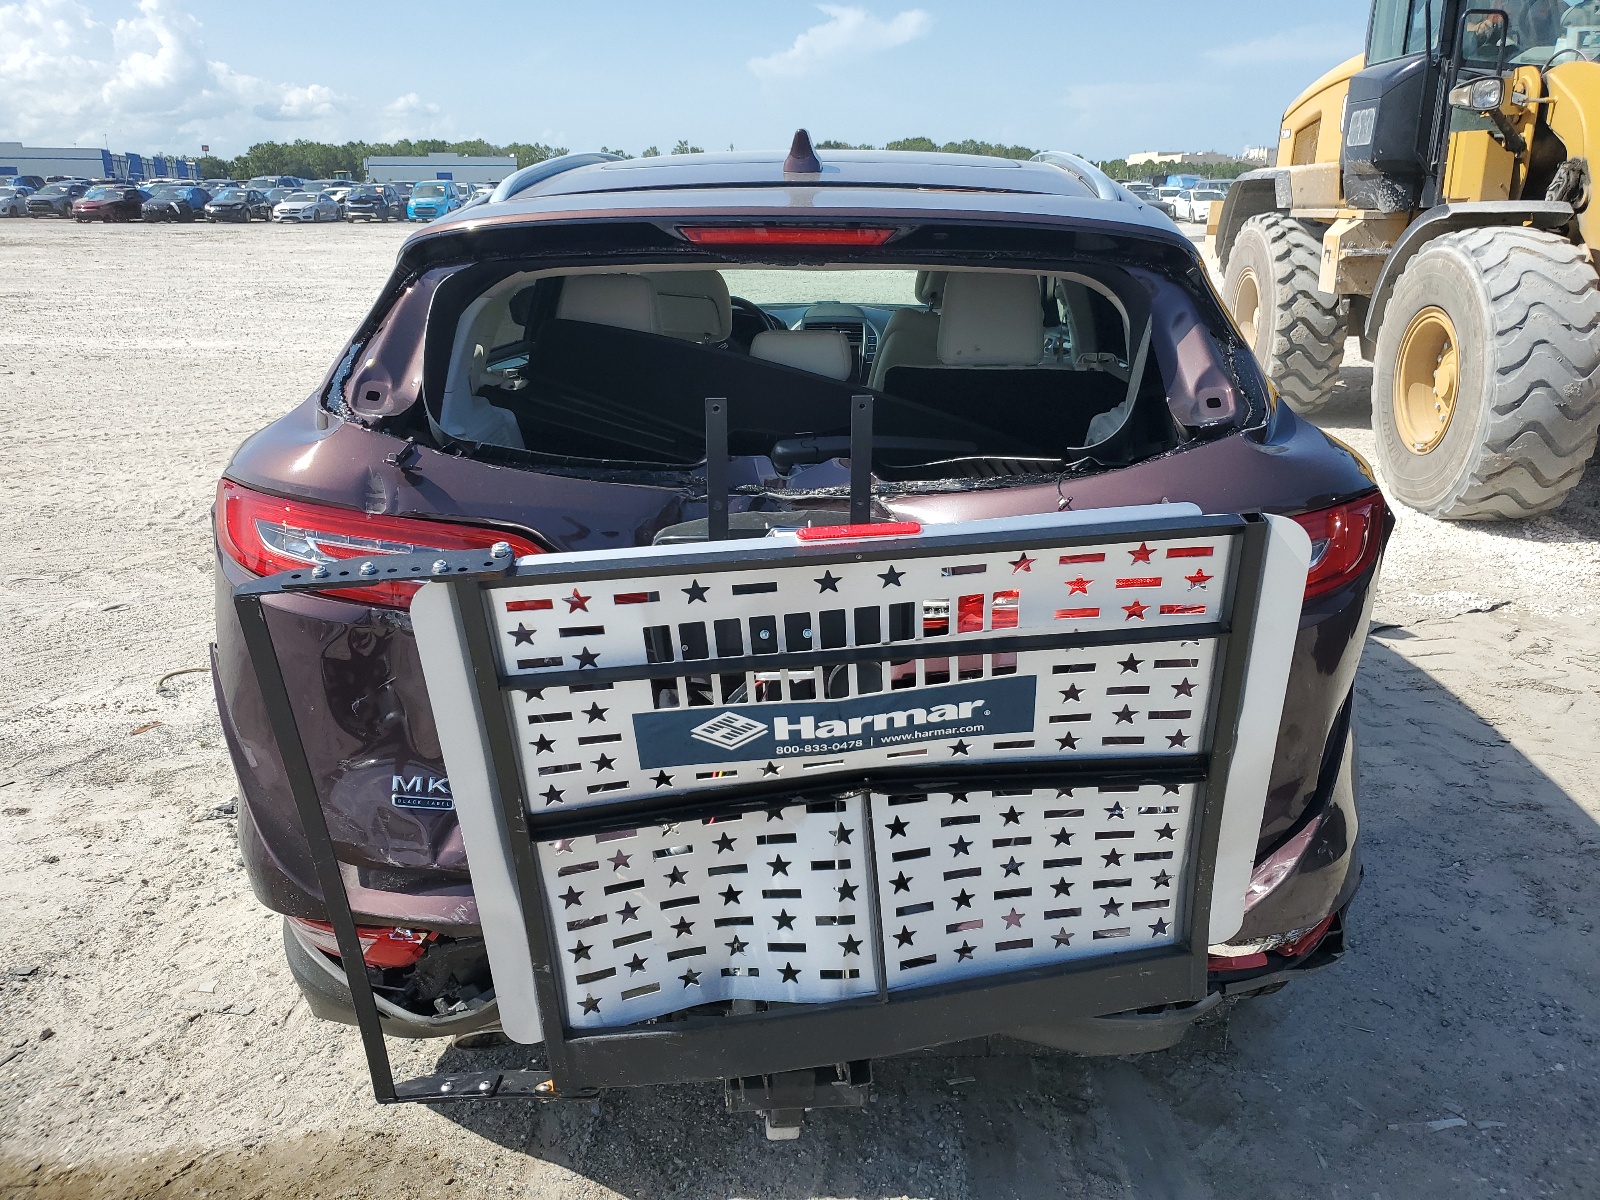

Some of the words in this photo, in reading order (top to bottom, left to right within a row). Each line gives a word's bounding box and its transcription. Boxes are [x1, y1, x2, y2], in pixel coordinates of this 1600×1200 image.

[776, 740, 863, 754] 800-833-0478
[881, 724, 985, 743] www.harmar.com
[397, 798, 421, 806] BLACK
